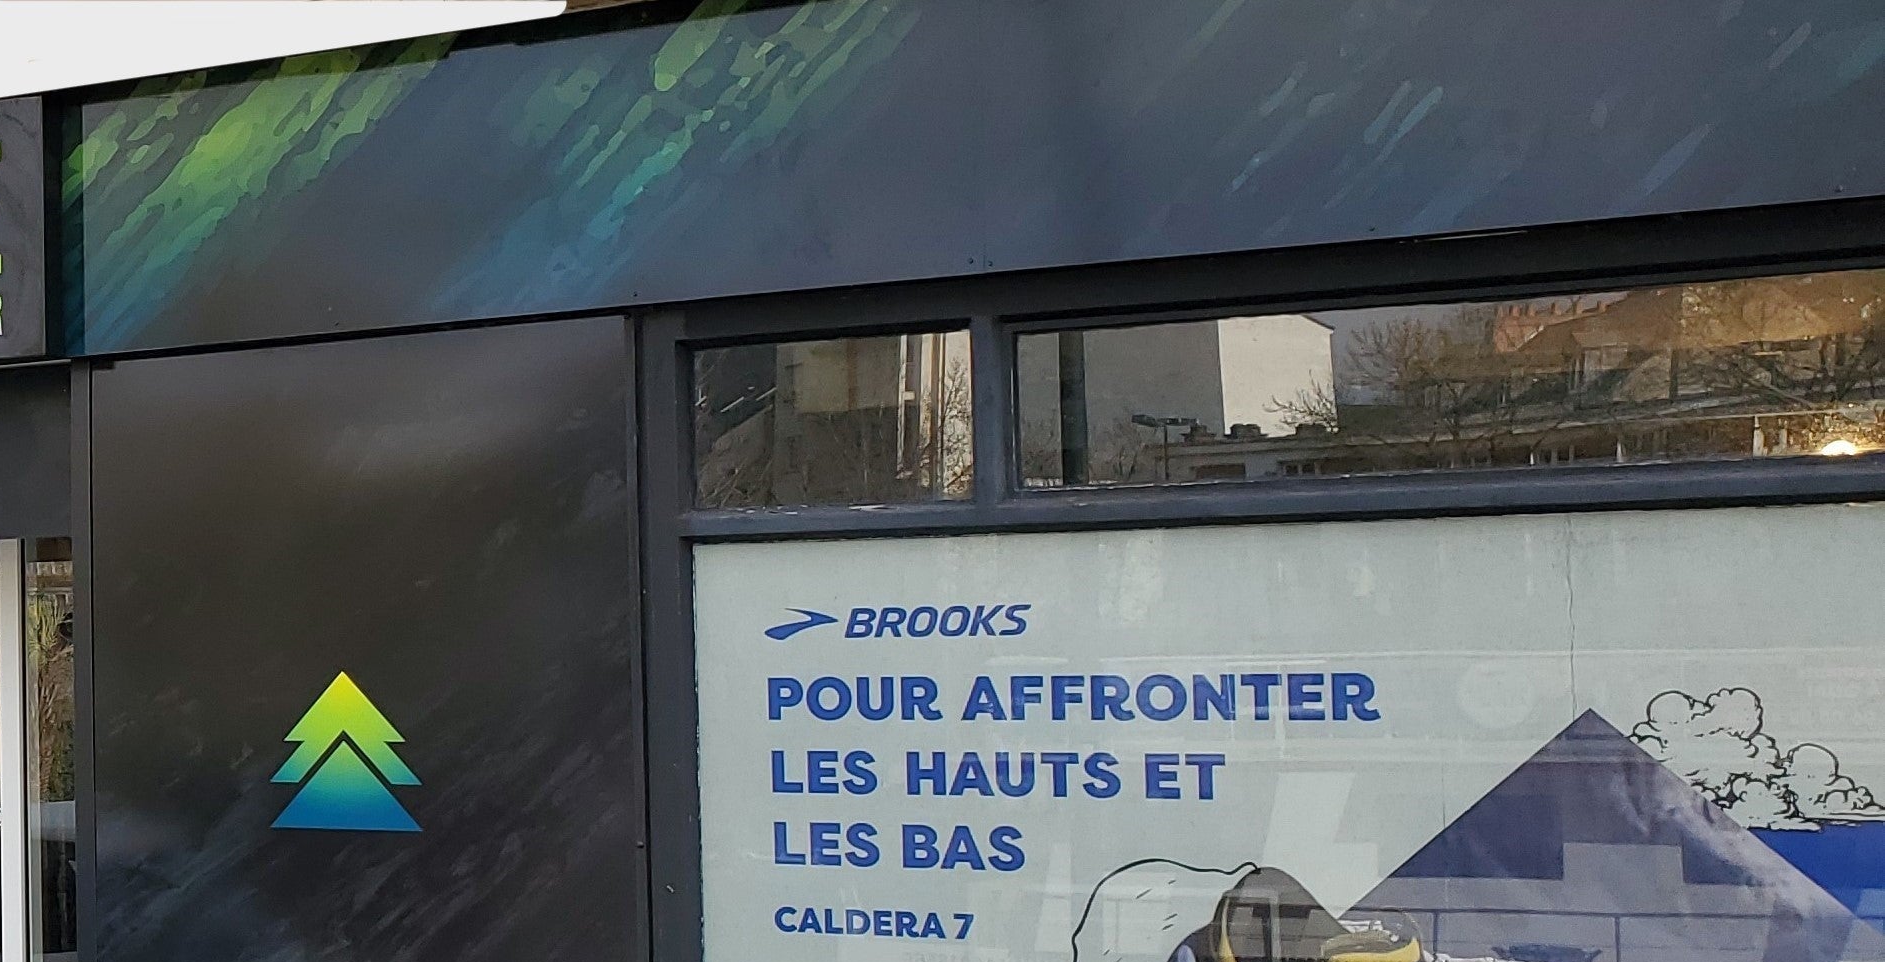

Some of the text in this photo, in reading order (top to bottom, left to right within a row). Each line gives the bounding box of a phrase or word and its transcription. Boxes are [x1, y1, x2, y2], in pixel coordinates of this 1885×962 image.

[844, 603, 1032, 640] BROOKS
[766, 671, 1381, 722] POUR AFFRONTER
[770, 749, 1226, 801] LES HAUTS ET
[773, 820, 1027, 873] LES BAS
[774, 905, 975, 941] CALDERA 7
